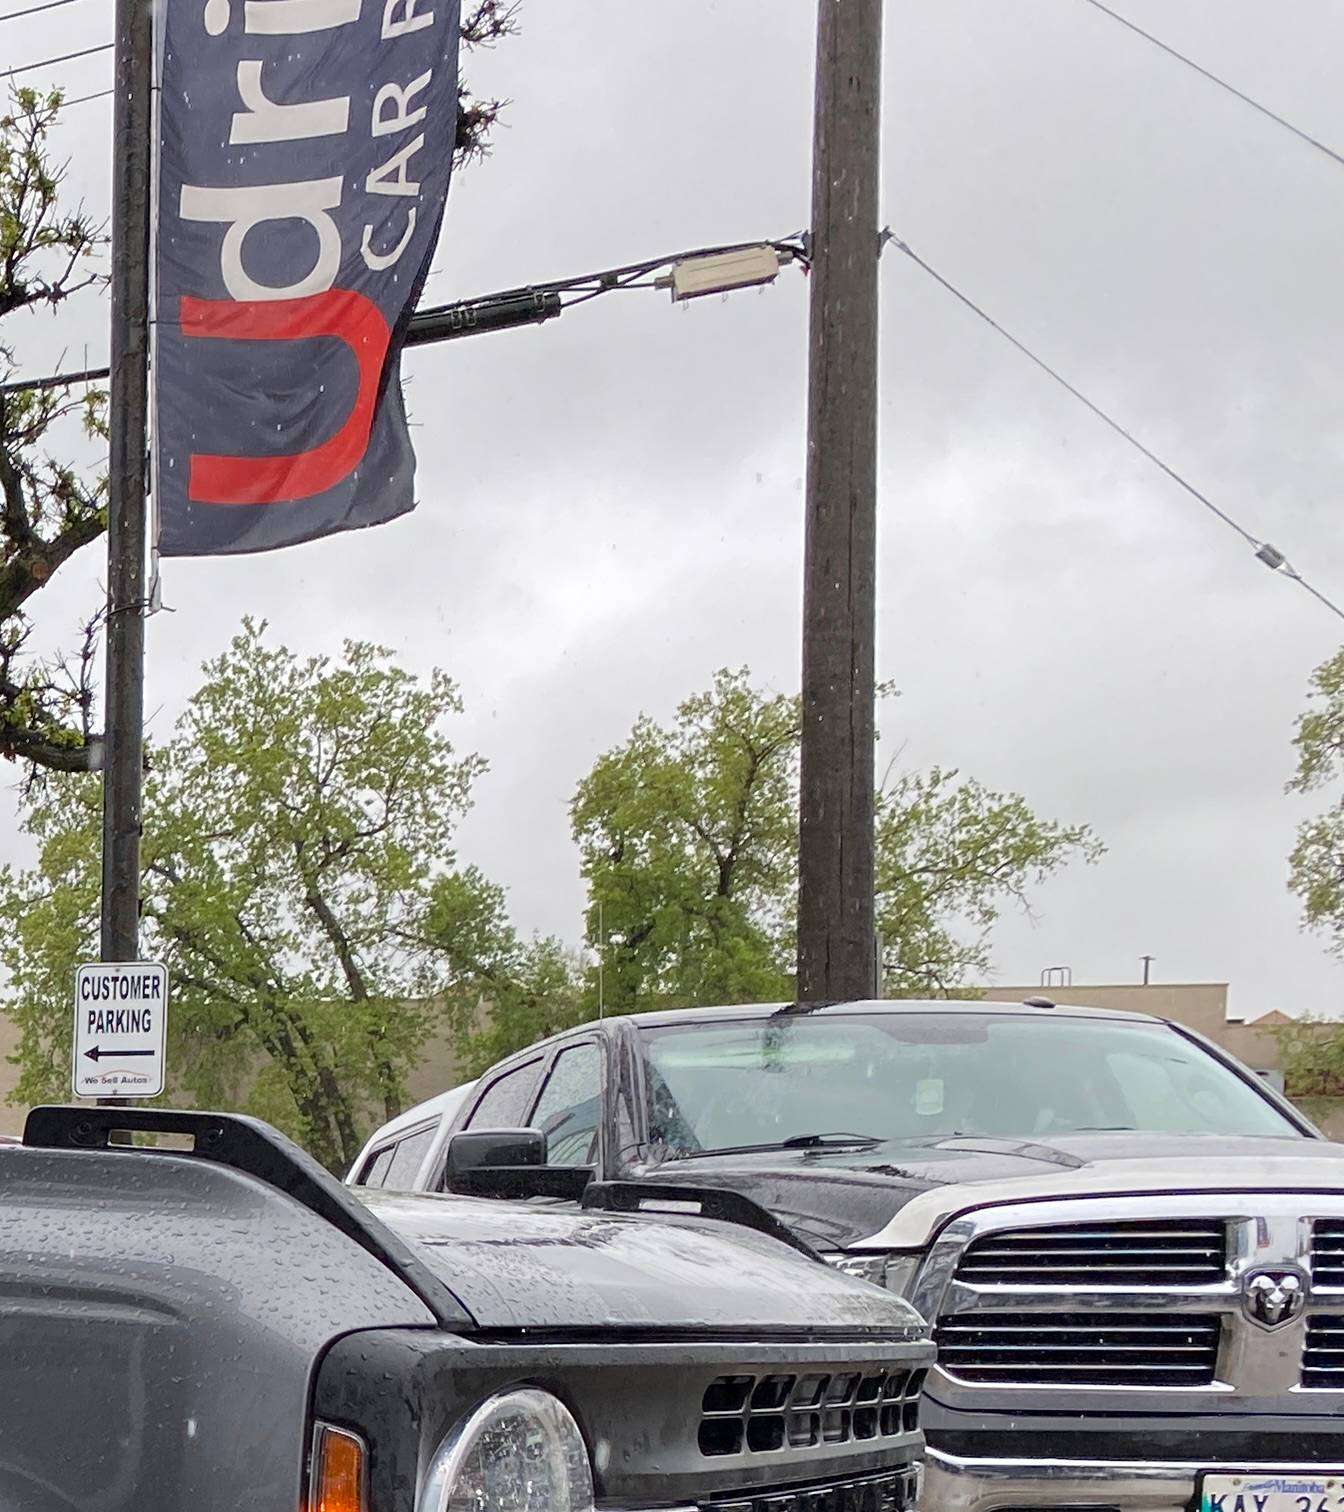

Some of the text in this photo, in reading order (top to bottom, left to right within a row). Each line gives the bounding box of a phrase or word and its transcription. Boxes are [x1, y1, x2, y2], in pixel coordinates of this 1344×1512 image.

[360, 68, 433, 271] CAR
[81, 975, 161, 1001] CUSTOMER
[87, 1008, 152, 1035] PARKING
[84, 1076, 148, 1085] We Sell Autos
[1273, 1479, 1325, 1494] Manitoba
